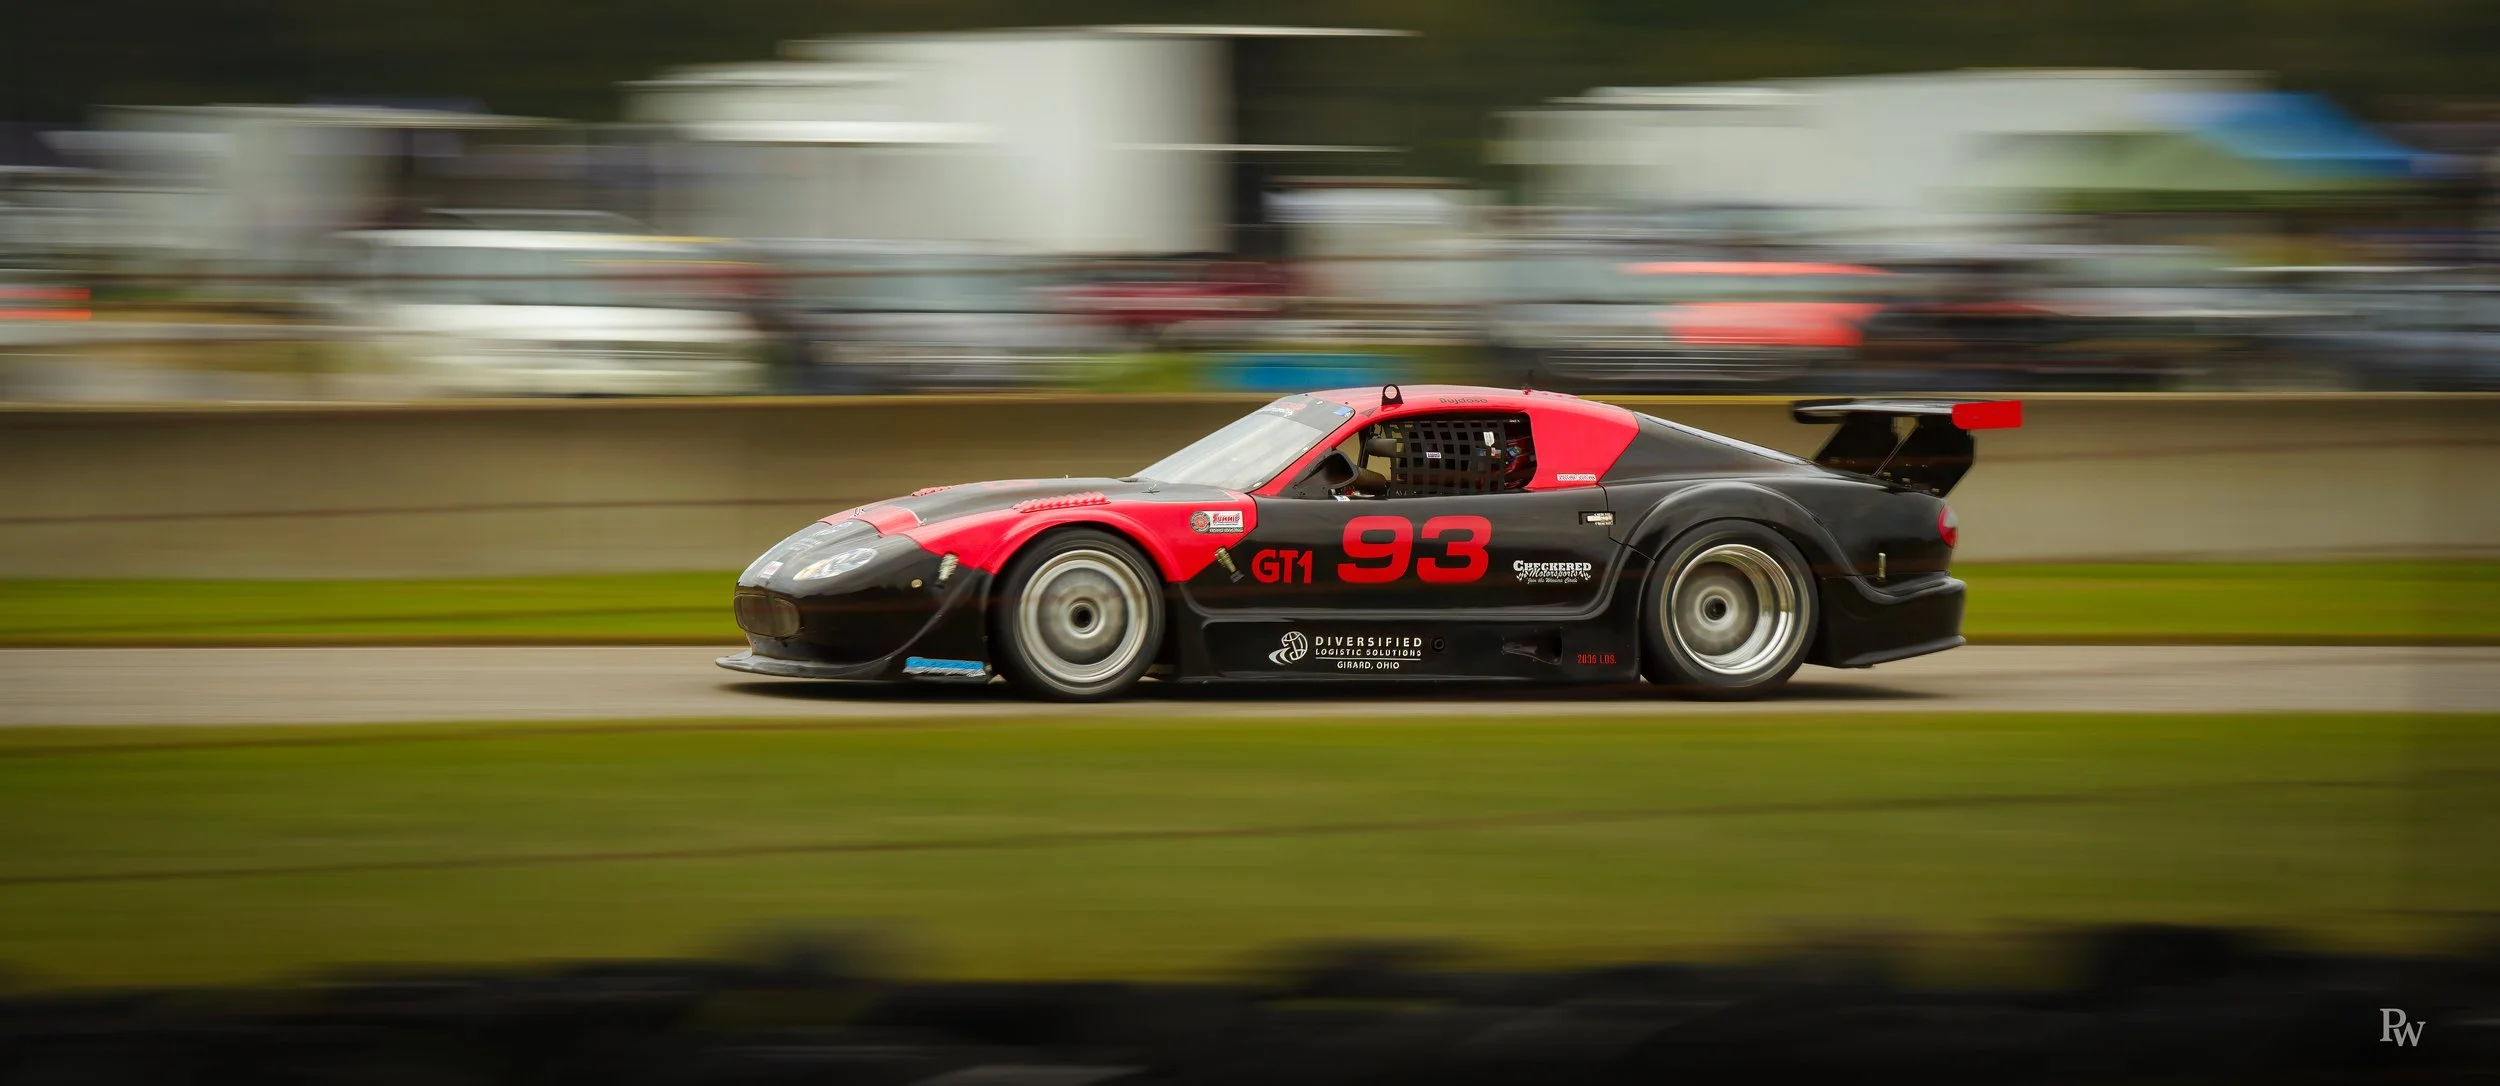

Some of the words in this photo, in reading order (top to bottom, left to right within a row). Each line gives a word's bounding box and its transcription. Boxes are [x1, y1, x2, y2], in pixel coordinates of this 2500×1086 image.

[1337, 515, 1493, 583] 93
[1251, 549, 1313, 584] GT1
[1513, 560, 1592, 571] CHECKERED
[1315, 636, 1422, 647] DIVERSIFIED
[1315, 648, 1362, 656] LOGISTIC
[1366, 649, 1422, 657] SOLUTIONS
[1337, 661, 1374, 670] GIRARD,
[1376, 661, 1400, 669] OHIO
